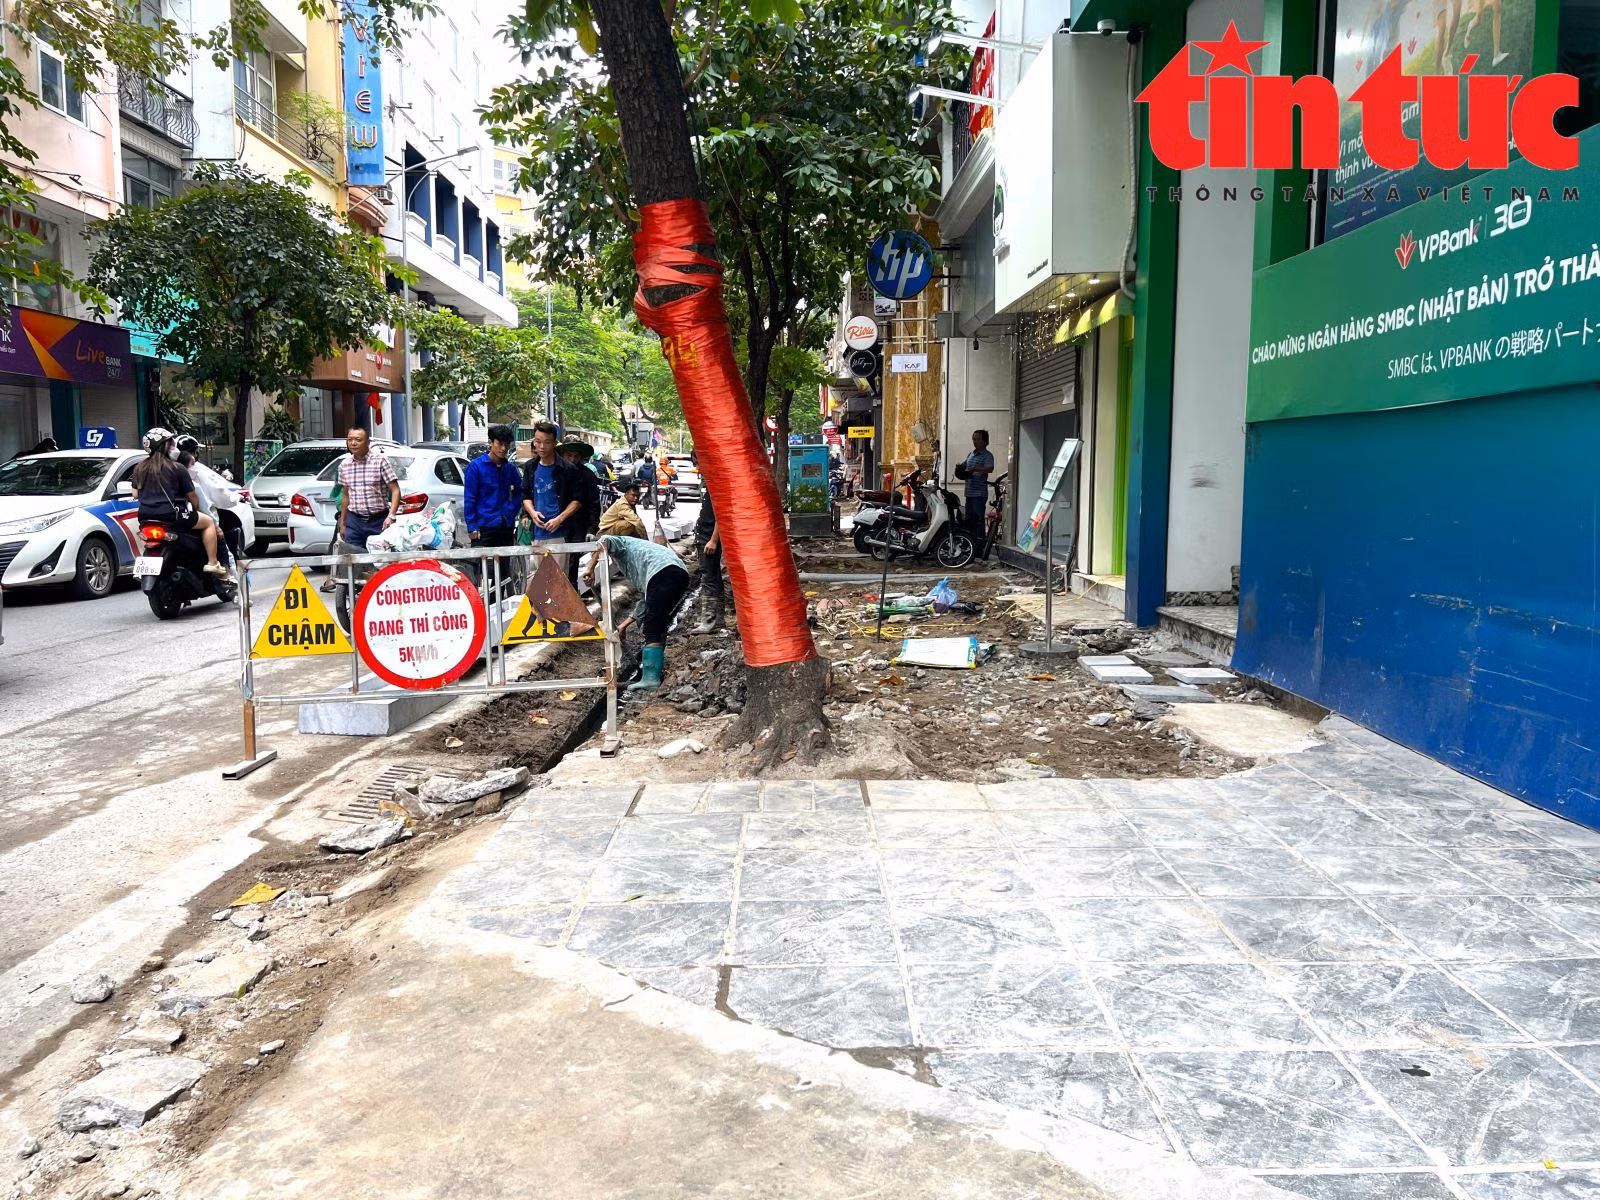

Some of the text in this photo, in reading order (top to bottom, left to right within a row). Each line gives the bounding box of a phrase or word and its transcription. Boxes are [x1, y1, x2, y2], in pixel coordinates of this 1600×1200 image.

[1418, 195, 1532, 263] VPBank 30
[875, 230, 924, 298] hp
[1252, 340, 1277, 364] CHÀO
[1278, 334, 1306, 358] MỪNG
[1307, 324, 1338, 351] NGÂN
[1340, 316, 1375, 343] HÀNG
[1376, 304, 1415, 334] SMBC
[1418, 287, 1465, 326] (NHẬT
[1467, 273, 1509, 311] BẢN)
[1513, 255, 1555, 298] TRỞ
[105, 356, 121, 368] BANK
[1388, 354, 1419, 379] SMBC
[1440, 338, 1493, 369] VPBANK
[86, 429, 104, 447] G7
[284, 587, 309, 611] ĐI
[268, 617, 335, 650] CHẬM
[369, 619, 404, 637] ĐANG
[433, 611, 468, 632] CÔNG
